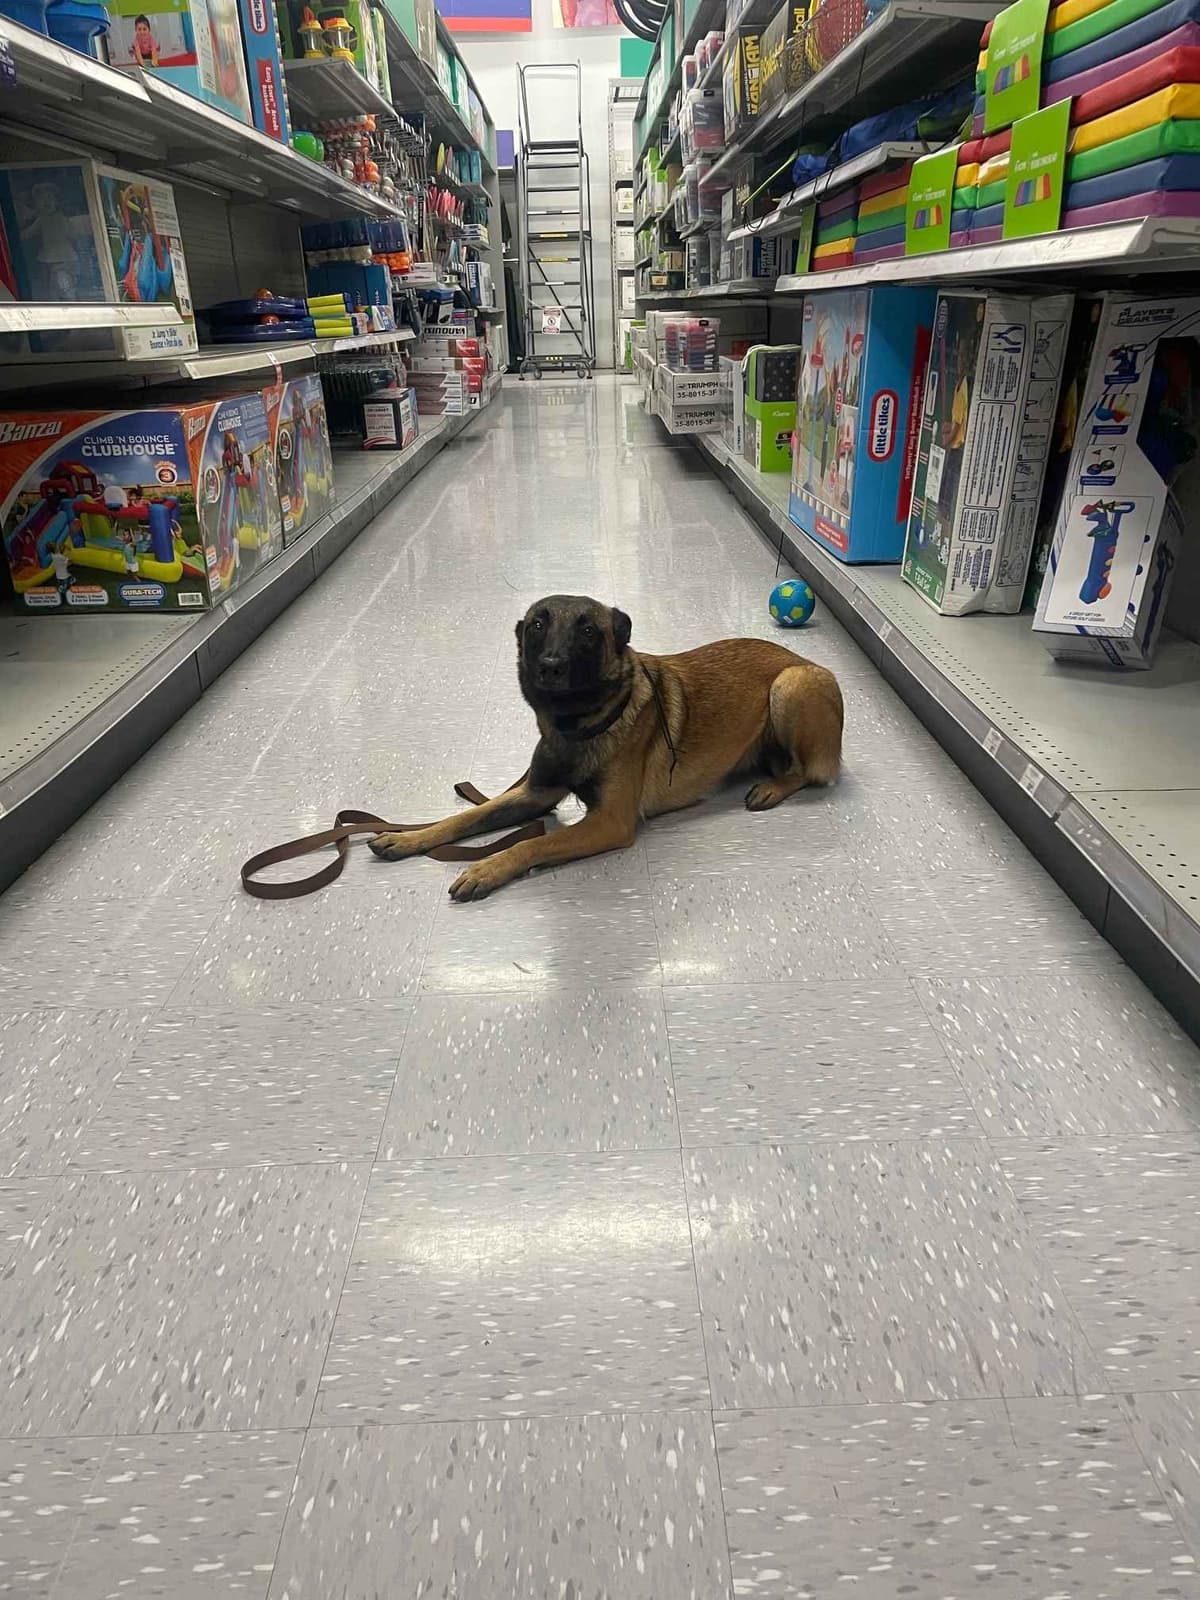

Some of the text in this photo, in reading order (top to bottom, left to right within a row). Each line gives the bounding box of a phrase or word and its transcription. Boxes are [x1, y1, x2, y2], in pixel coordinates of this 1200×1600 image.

[685, 410, 715, 418] TRIUMPH
[0, 422, 62, 443] Banzai
[874, 397, 890, 454] little tikes
